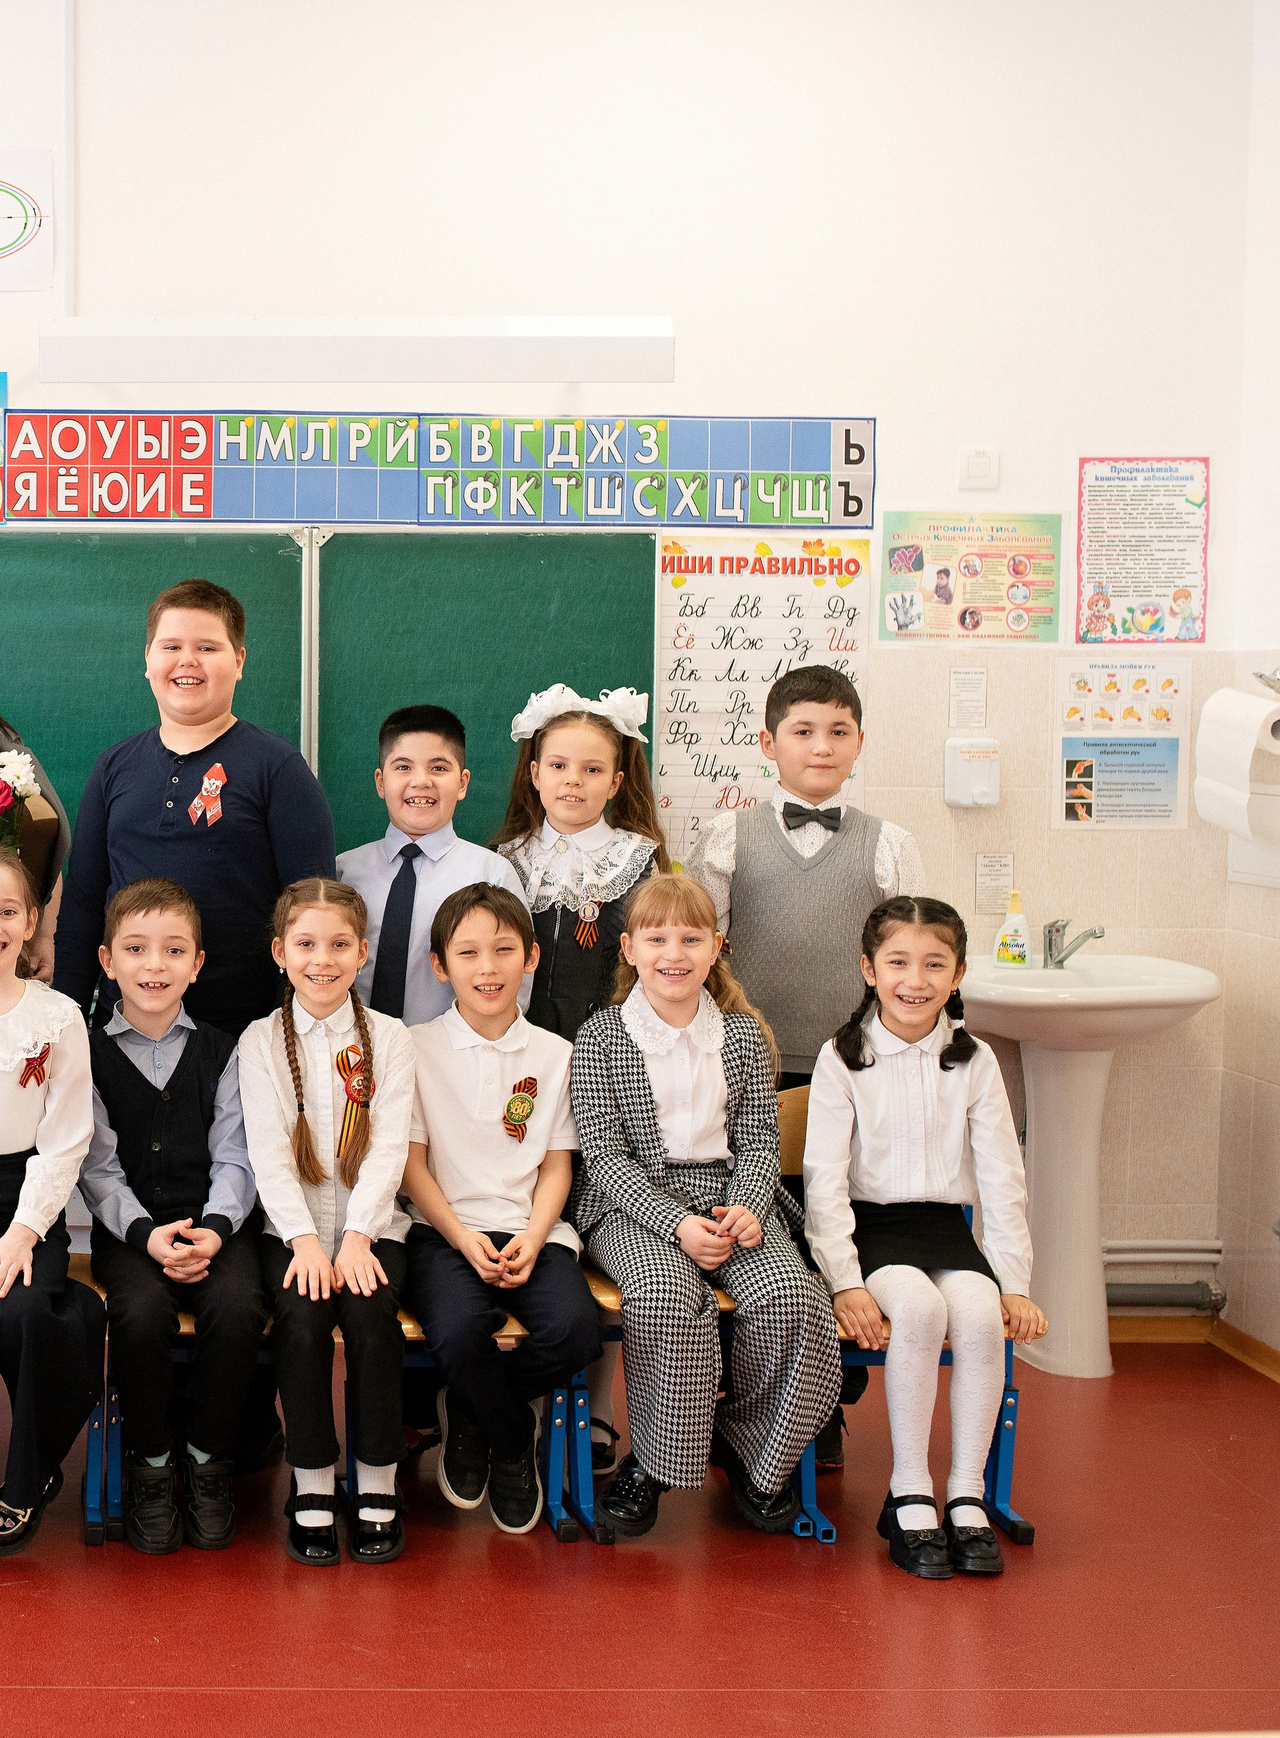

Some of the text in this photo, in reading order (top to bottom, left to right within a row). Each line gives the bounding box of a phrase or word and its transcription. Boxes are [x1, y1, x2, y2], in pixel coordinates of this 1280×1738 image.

[10, 418, 867, 470] А О У Ы Э Н М Л Р Й Б В Г Д Ж З Ь
[1109, 465, 1180, 475] Профилактика
[1143, 474, 1196, 482] заболеваний
[12, 466, 865, 524] Я Ё Ю И Е П Ф К Т Ш С Х Ц Ч Щ Ъ
[927, 524, 1018, 534] ПРОФИЛАКТИКА
[662, 555, 861, 577] ИШИ ПРАВИЛЬНО
[678, 593, 861, 627] Бб Вв Гг Дд
[672, 622, 860, 662] Ёё Жж Зз Ии
[667, 657, 751, 683] Кк Лл
[665, 688, 755, 723] Пп Рр
[665, 720, 703, 754] Фф
[690, 752, 741, 783] Щщ
[690, 816, 700, 832] 2
[999, 941, 1026, 949] Absolut
[513, 1101, 528, 1116] 80
